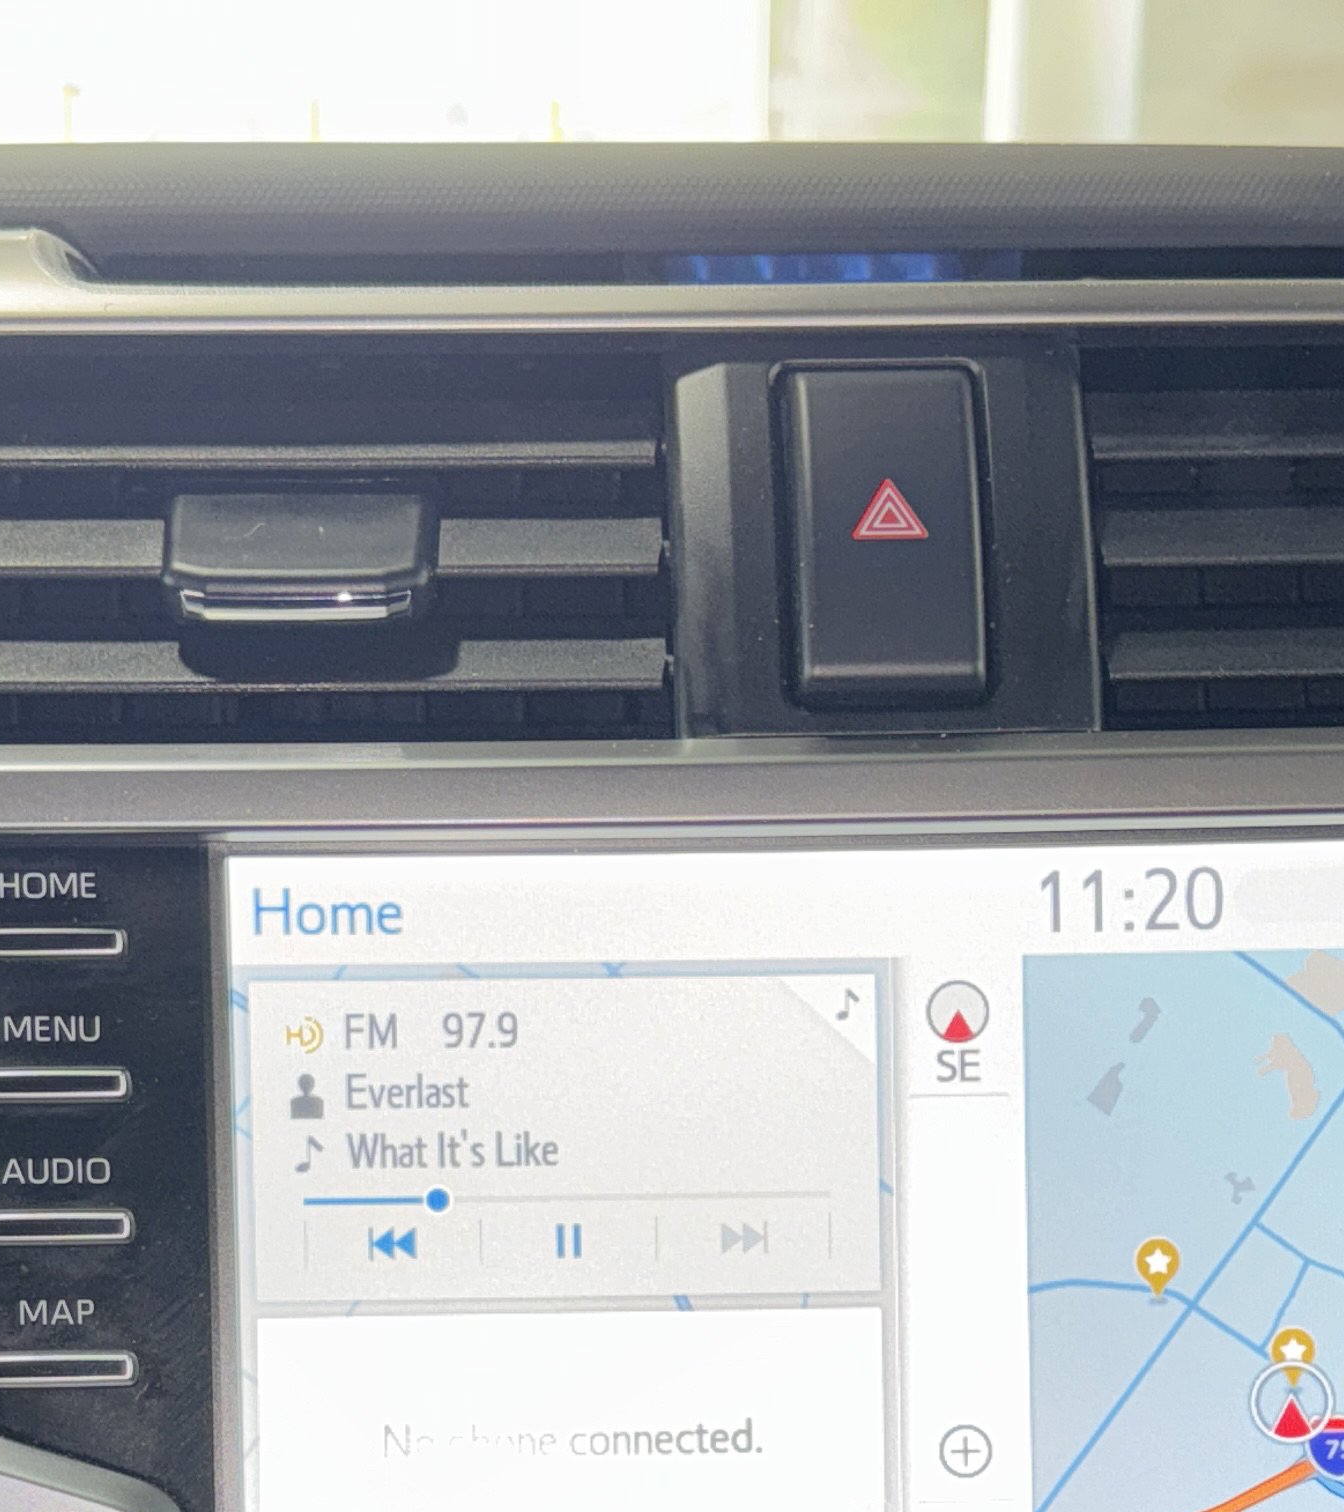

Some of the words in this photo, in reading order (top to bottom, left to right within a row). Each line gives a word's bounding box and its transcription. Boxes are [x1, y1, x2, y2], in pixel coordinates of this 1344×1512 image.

[252, 887, 404, 937] Home
[1039, 865, 1224, 934] 11:20
[2, 1015, 102, 1043] MENU
[345, 1012, 399, 1050] FM
[442, 1011, 519, 1049] 97.9
[936, 1049, 983, 1084] SE
[345, 1072, 470, 1109] Everlast
[346, 1132, 428, 1169] What
[437, 1127, 486, 1168] It's
[495, 1130, 560, 1167] Like
[2, 1157, 112, 1186] AUDIO
[18, 1299, 96, 1326] MAP
[569, 1416, 764, 1456] connected.
